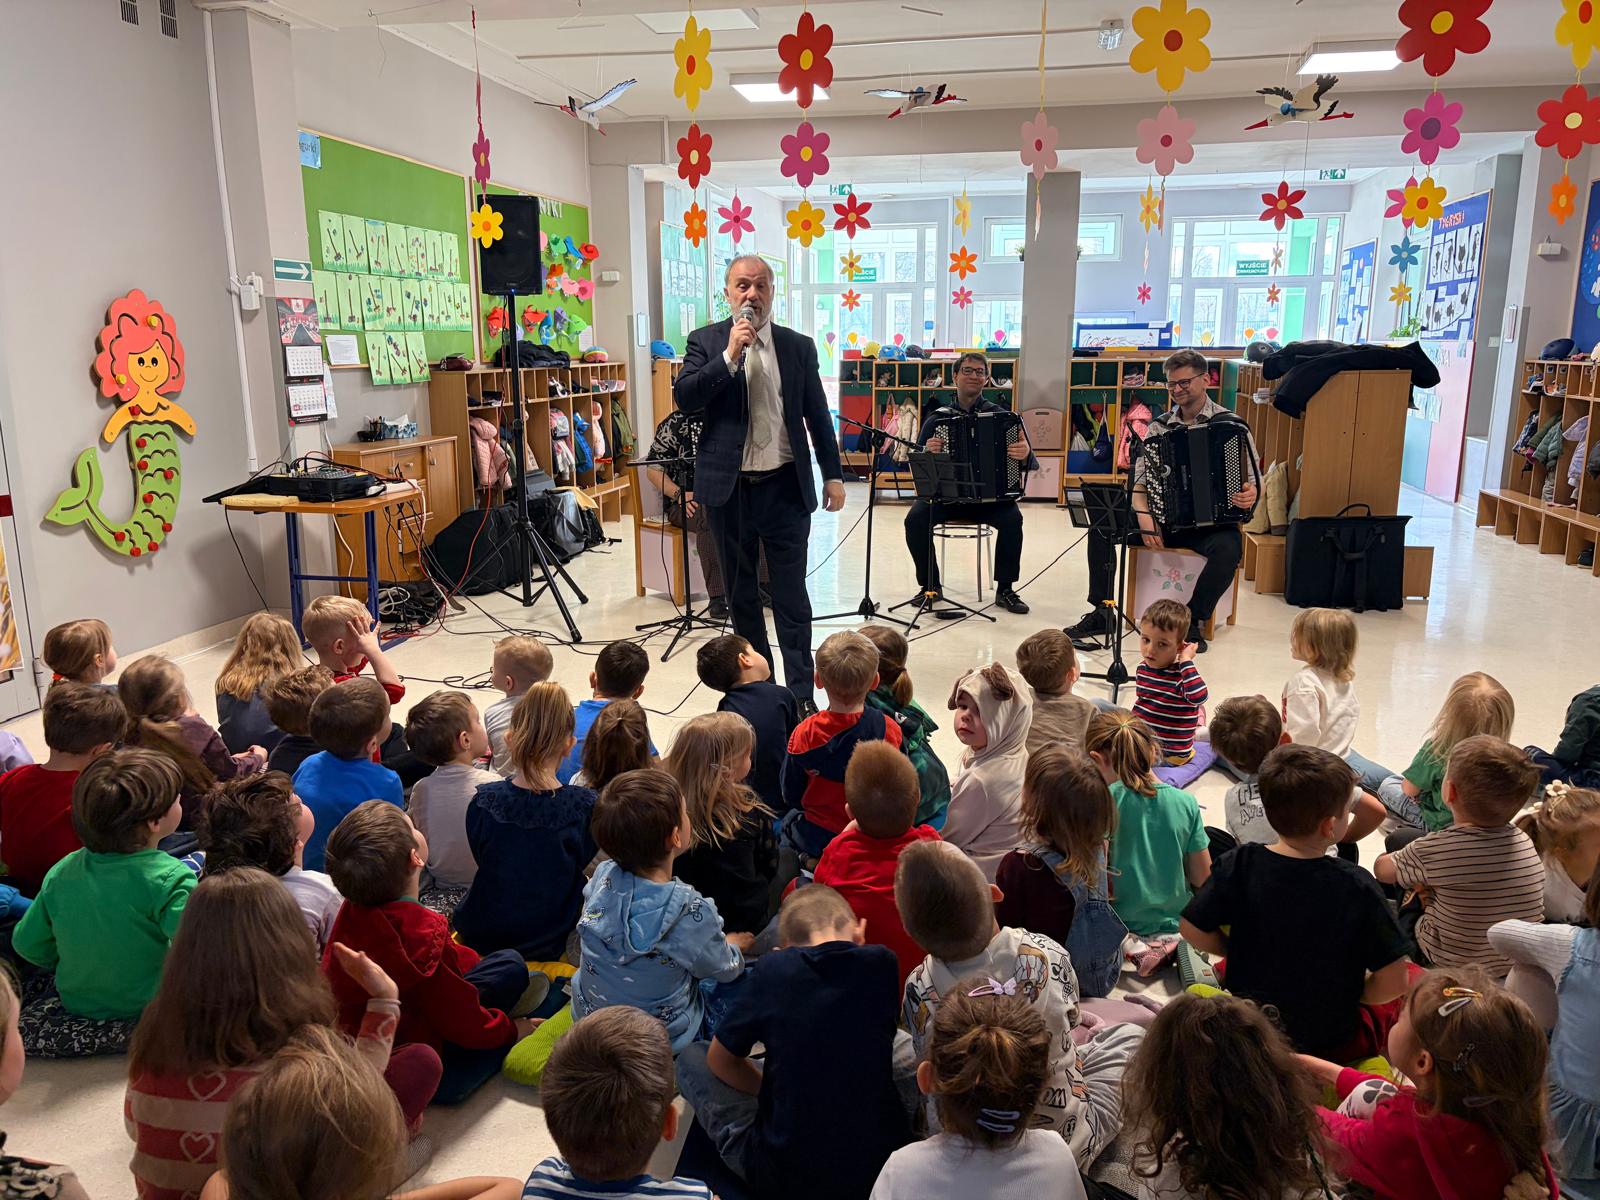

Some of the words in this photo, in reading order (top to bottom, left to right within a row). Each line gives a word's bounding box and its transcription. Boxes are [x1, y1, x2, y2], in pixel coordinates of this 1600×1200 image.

[538, 197, 563, 218] NIKI
[1236, 783, 1260, 806] TE
[1240, 805, 1263, 825] AVE
